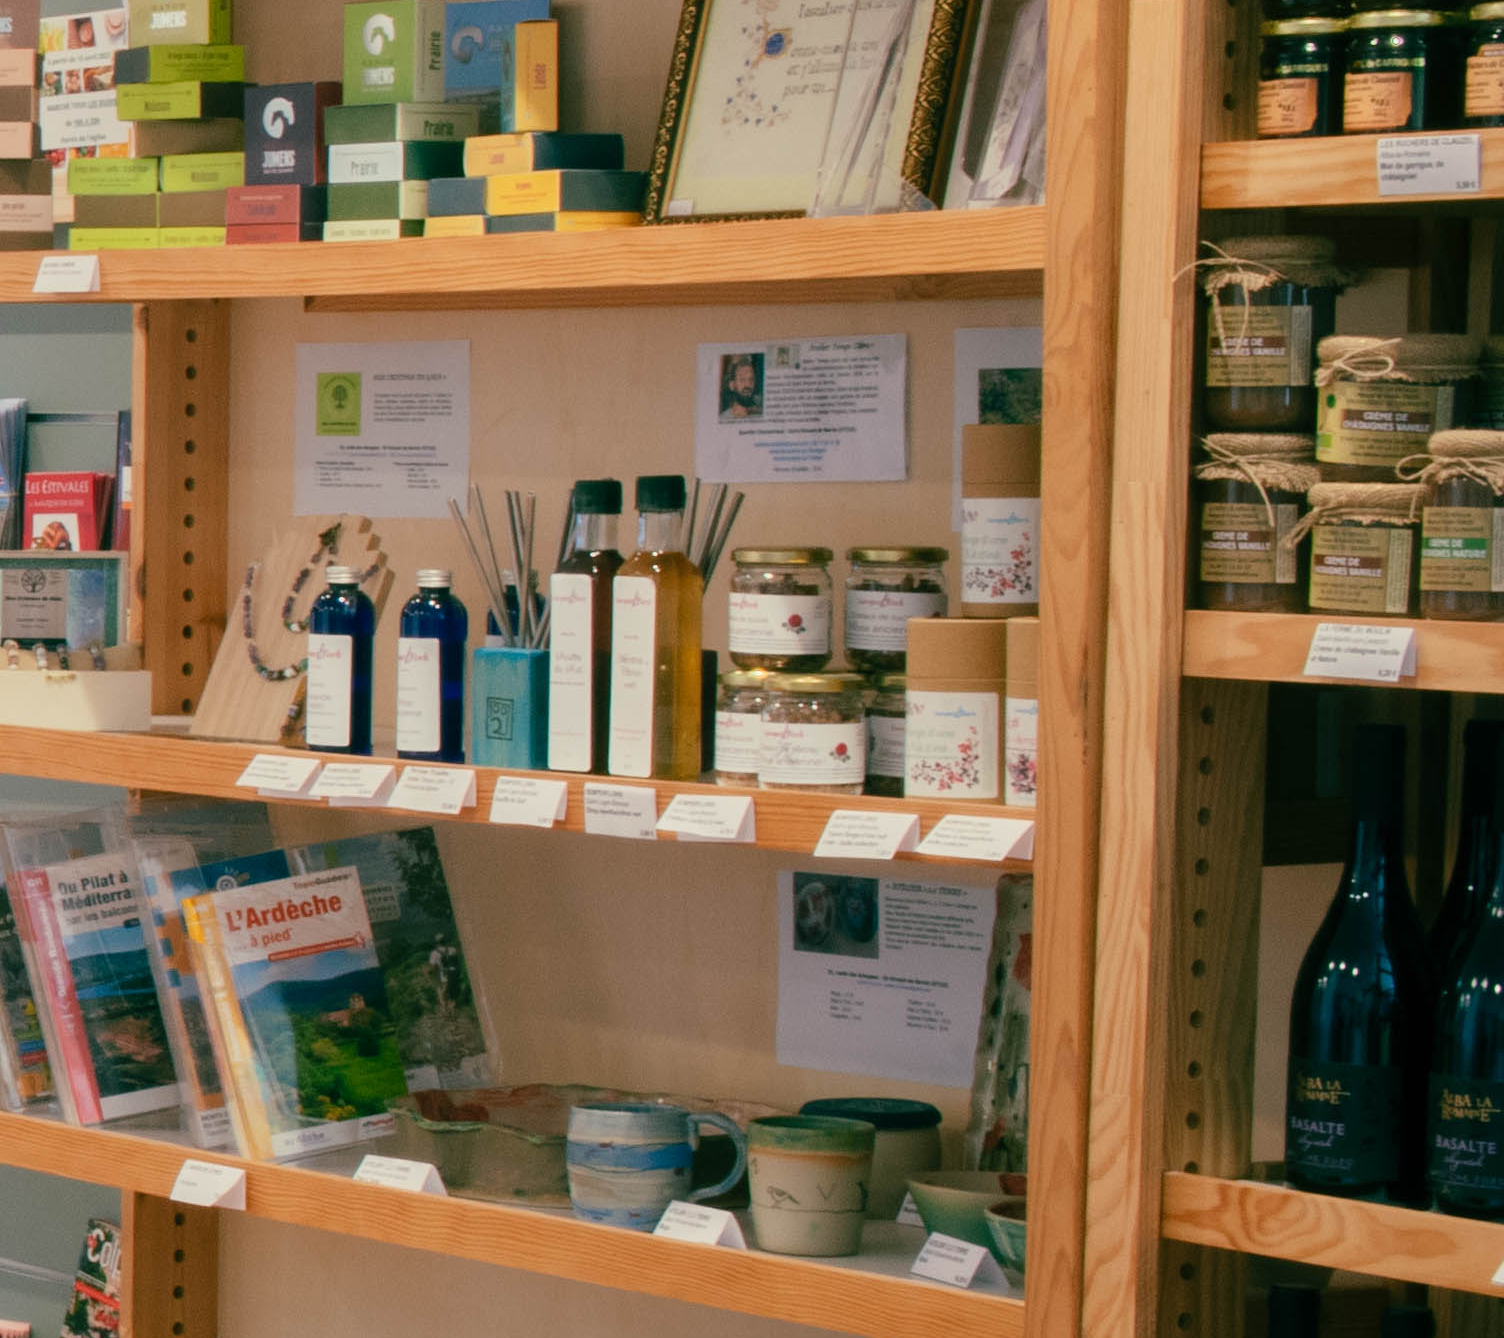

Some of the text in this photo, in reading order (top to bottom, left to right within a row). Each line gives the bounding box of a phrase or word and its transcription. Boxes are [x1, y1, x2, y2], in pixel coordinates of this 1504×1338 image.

[429, 31, 442, 71] Prairie
[424, 120, 454, 137] Prairie
[1395, 412, 1409, 421] DE
[58, 869, 129, 895] Du Pilat à
[61, 888, 133, 911] Méditerra
[225, 893, 342, 933] L'Ardèche
[250, 934, 259, 948] à
[1326, 1080, 1341, 1091] LA
[1476, 1097, 1492, 1108] LA
[1435, 1135, 1497, 1155] BASALTE
